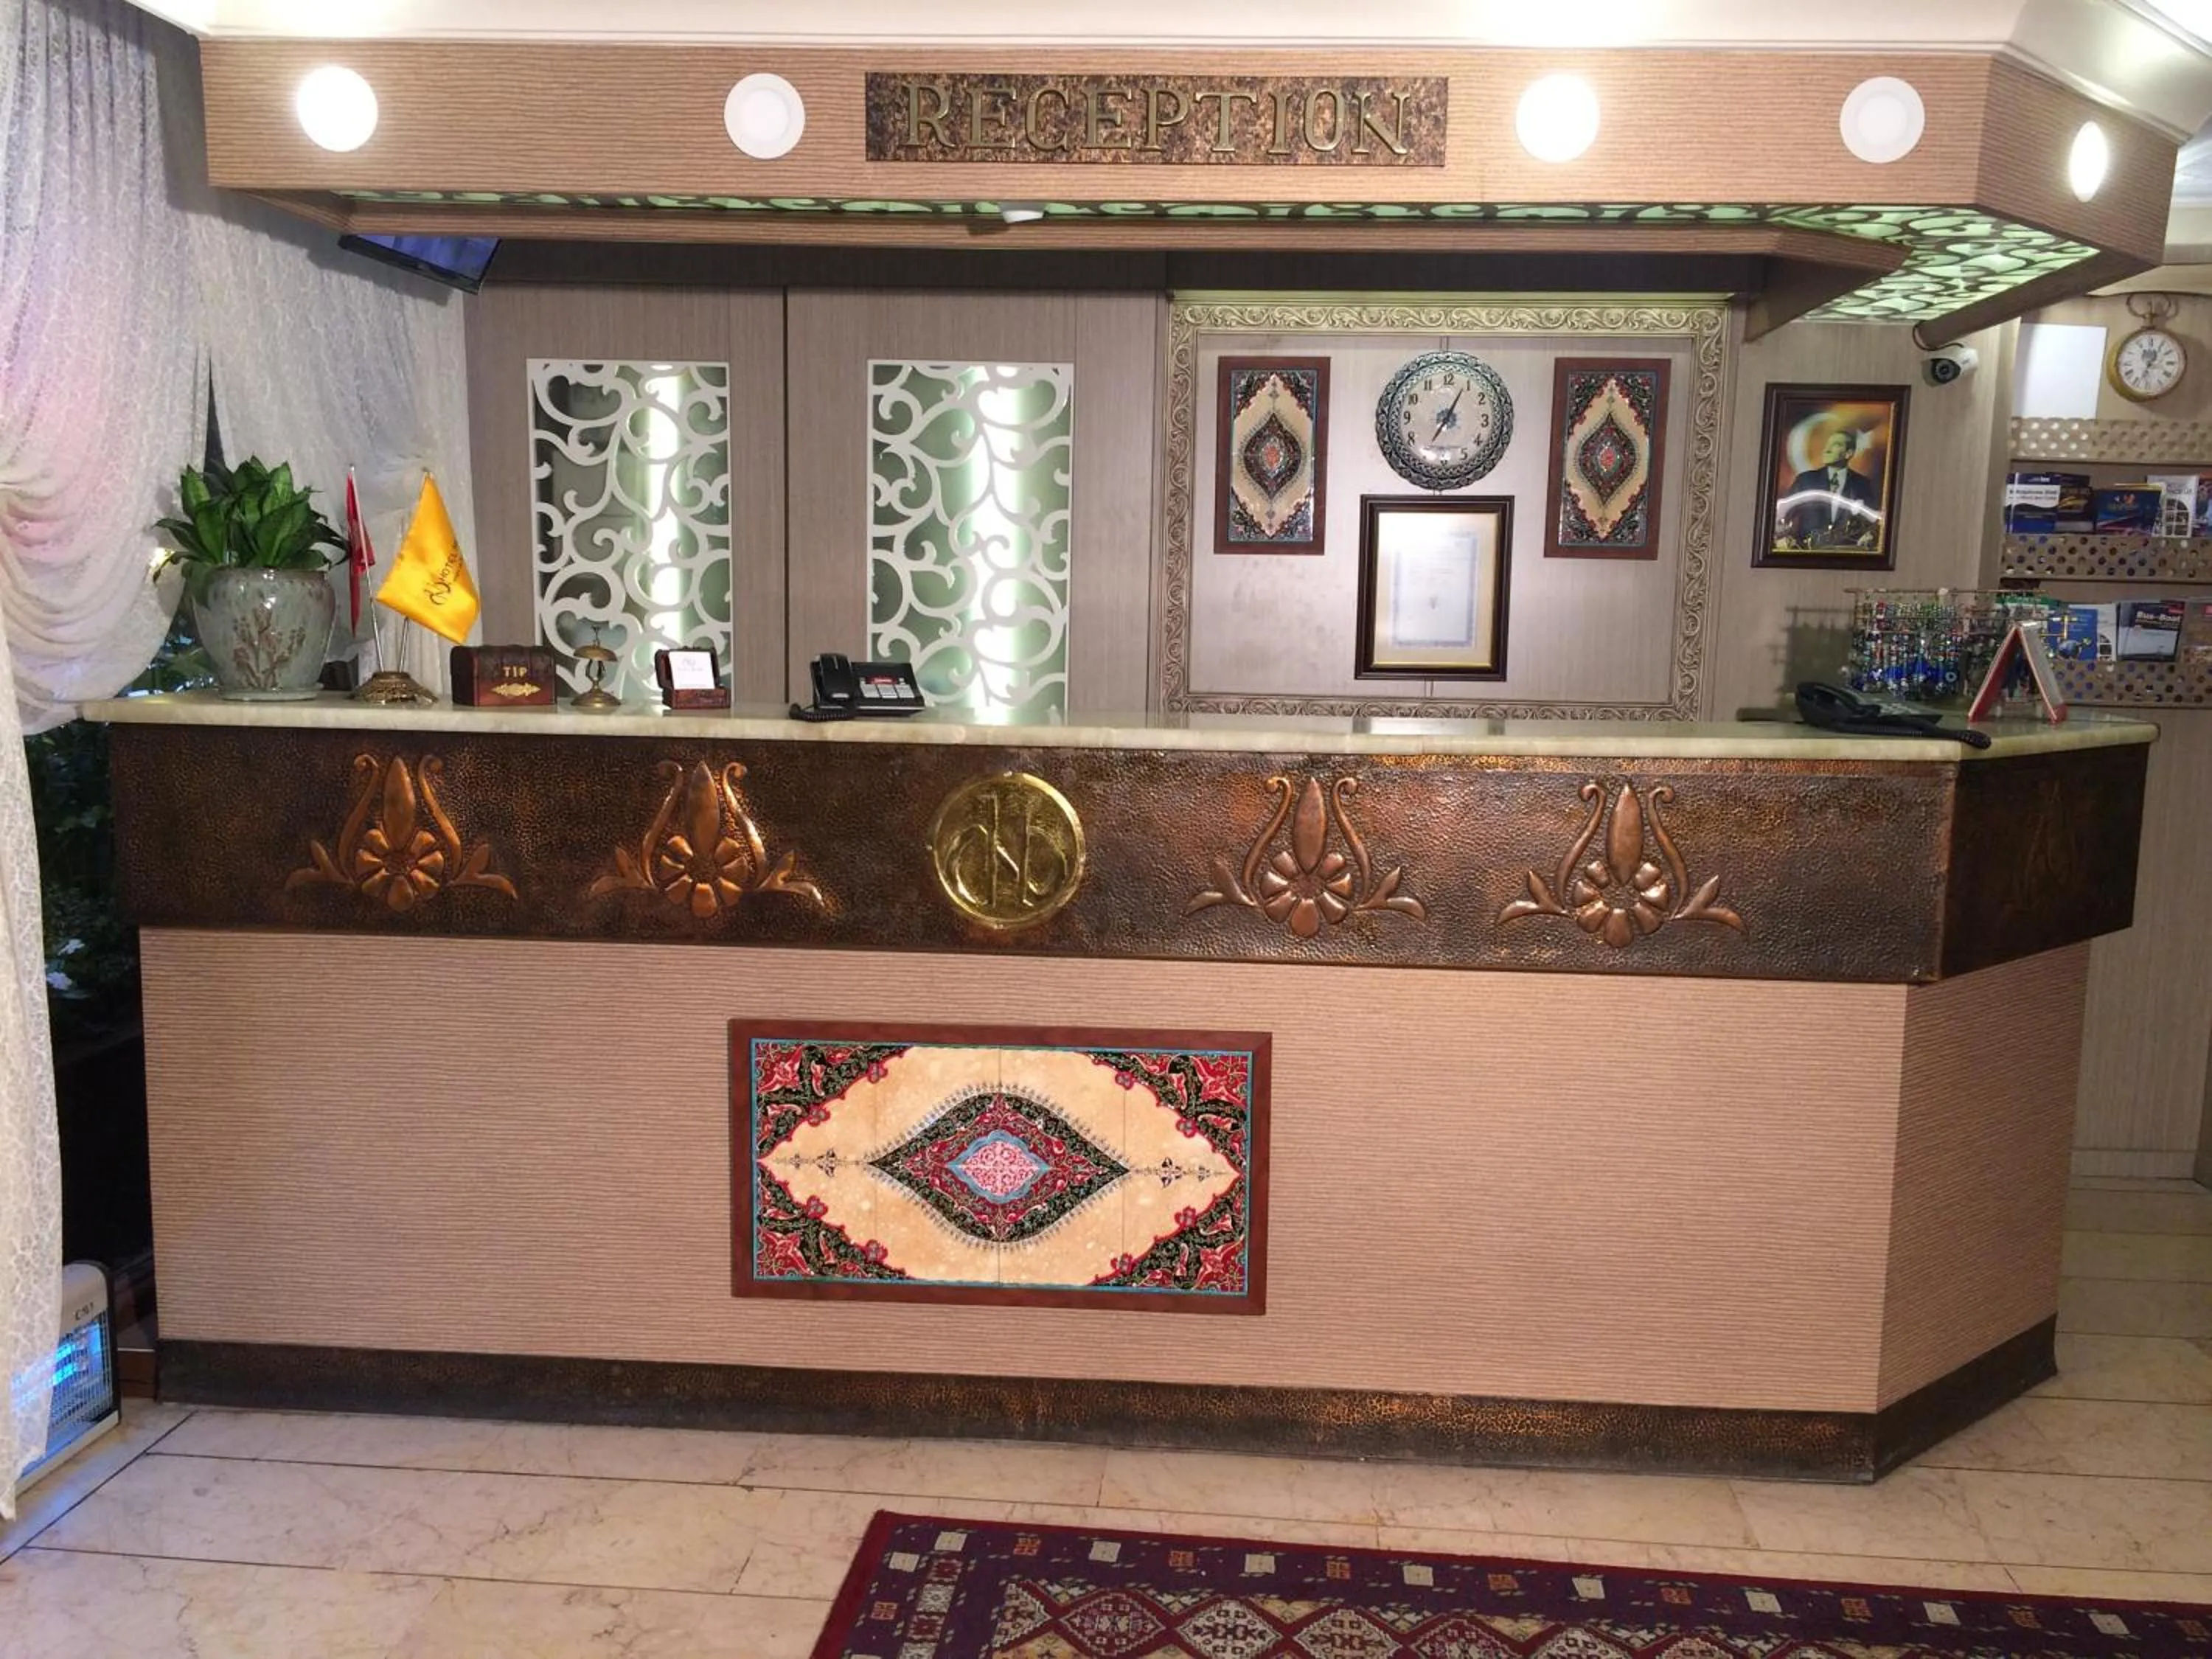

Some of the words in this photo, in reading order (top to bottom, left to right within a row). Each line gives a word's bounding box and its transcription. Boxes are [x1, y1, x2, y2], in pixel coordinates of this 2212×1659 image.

[901, 82, 1411, 155] RECEPTION
[1424, 380, 1432, 391] 11
[1443, 374, 1455, 386] 12
[1466, 380, 1470, 391] 1
[1408, 394, 1418, 405] 10
[1478, 392, 1486, 405] 2
[1403, 412, 1411, 425] 9
[1481, 414, 1489, 428] 3
[1408, 432, 1415, 445] 8
[1473, 434, 1482, 446] 4
[1460, 448, 1468, 460] 5
[502, 666, 528, 678] TIP
